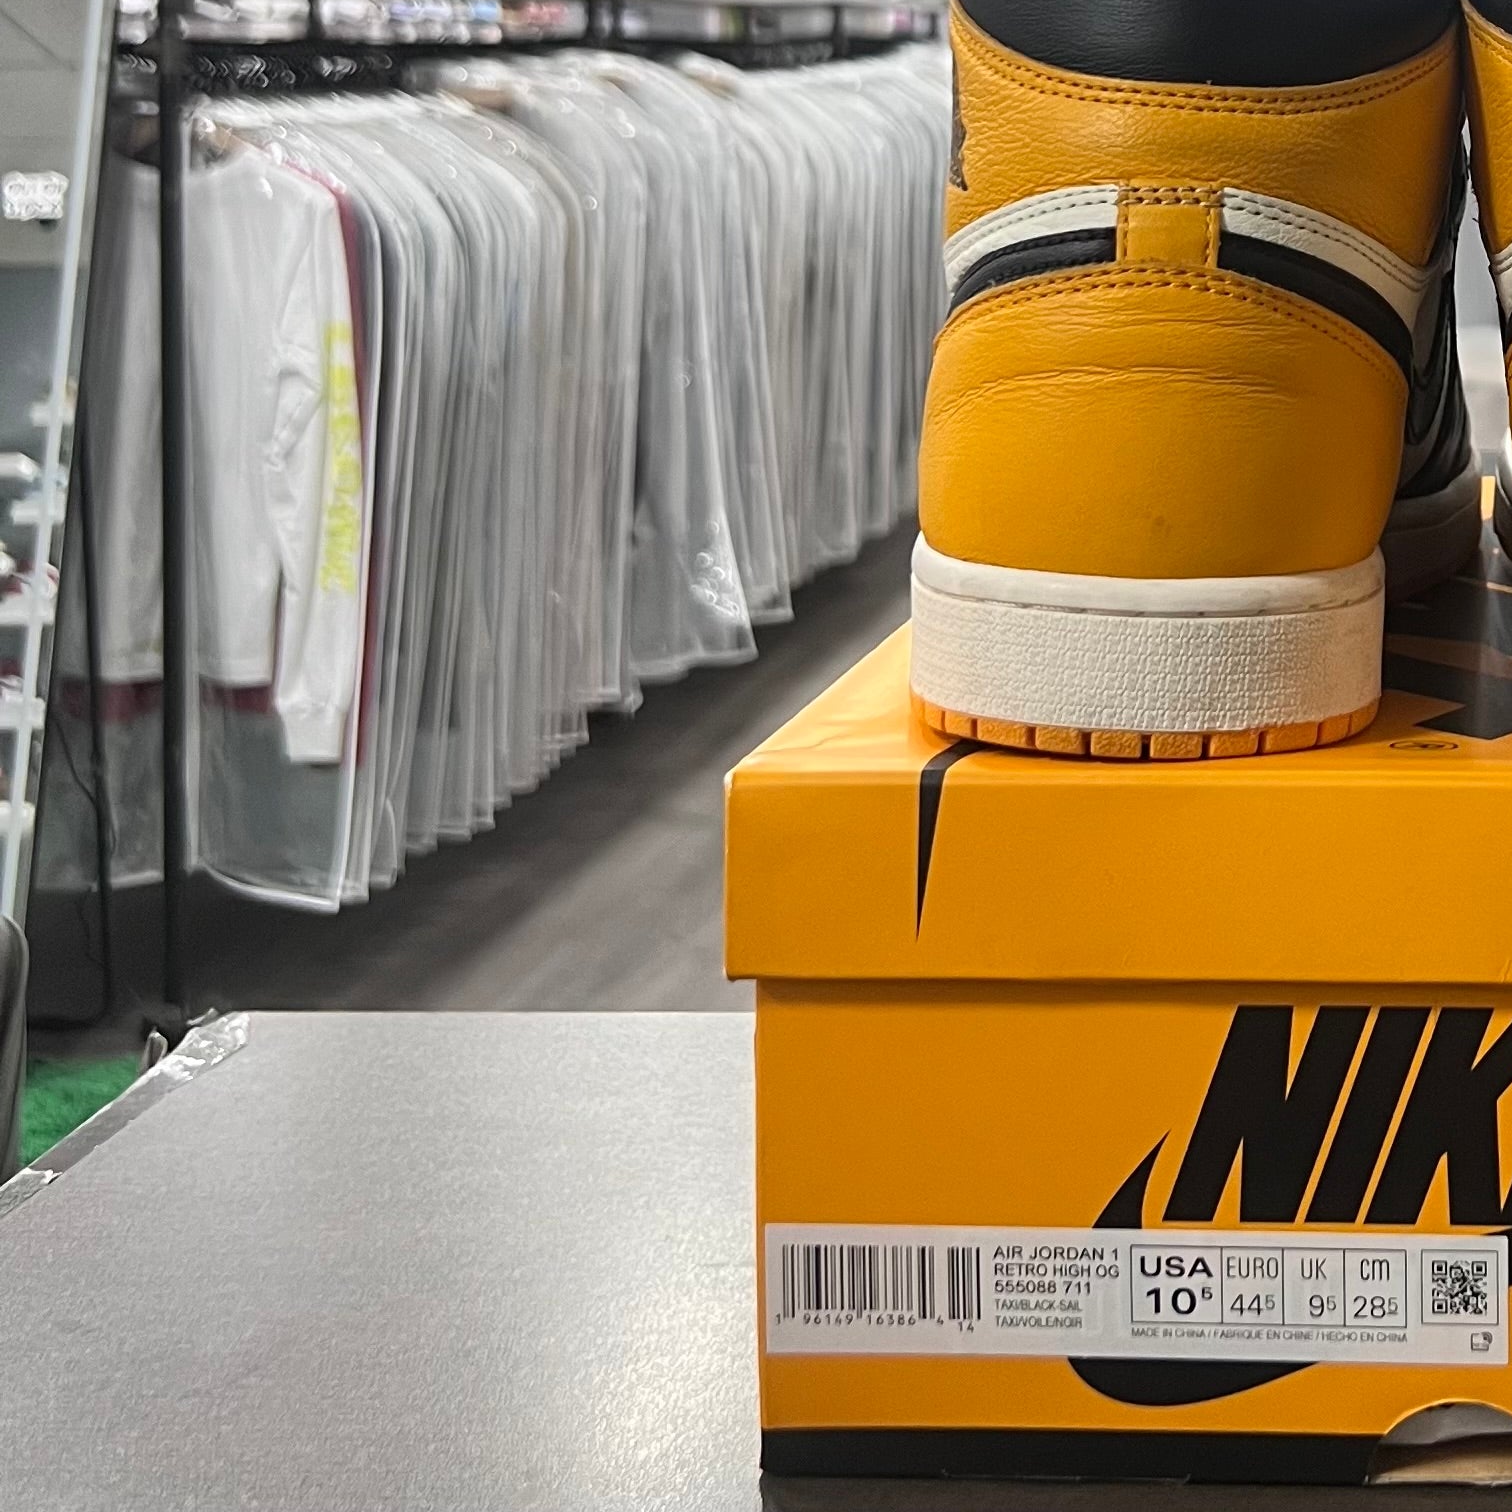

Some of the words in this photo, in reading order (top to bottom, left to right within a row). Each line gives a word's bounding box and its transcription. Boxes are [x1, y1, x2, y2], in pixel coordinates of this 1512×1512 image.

[992, 1245, 1023, 1259] AIR
[1029, 1246, 1104, 1261] JORDAN
[1111, 1248, 1118, 1261] 1
[994, 1262, 1048, 1276] RETRO
[1053, 1263, 1091, 1278] HIGH
[1095, 1264, 1120, 1278] OG
[1140, 1255, 1213, 1278] USA
[1226, 1256, 1279, 1279] EURO
[1301, 1257, 1327, 1280] UK
[994, 1279, 1057, 1294] 555088
[1063, 1280, 1091, 1296] 711
[1131, 1327, 1160, 1337] MADE
[1162, 1328, 1173, 1337] IN
[1174, 1328, 1206, 1338] CHINA
[1213, 1329, 1264, 1340] FABRIQUE
[1266, 1329, 1281, 1340] EN
[1321, 1331, 1358, 1342] HECHO
[1360, 1332, 1374, 1343] EN
[1376, 1332, 1408, 1343] CHINA
